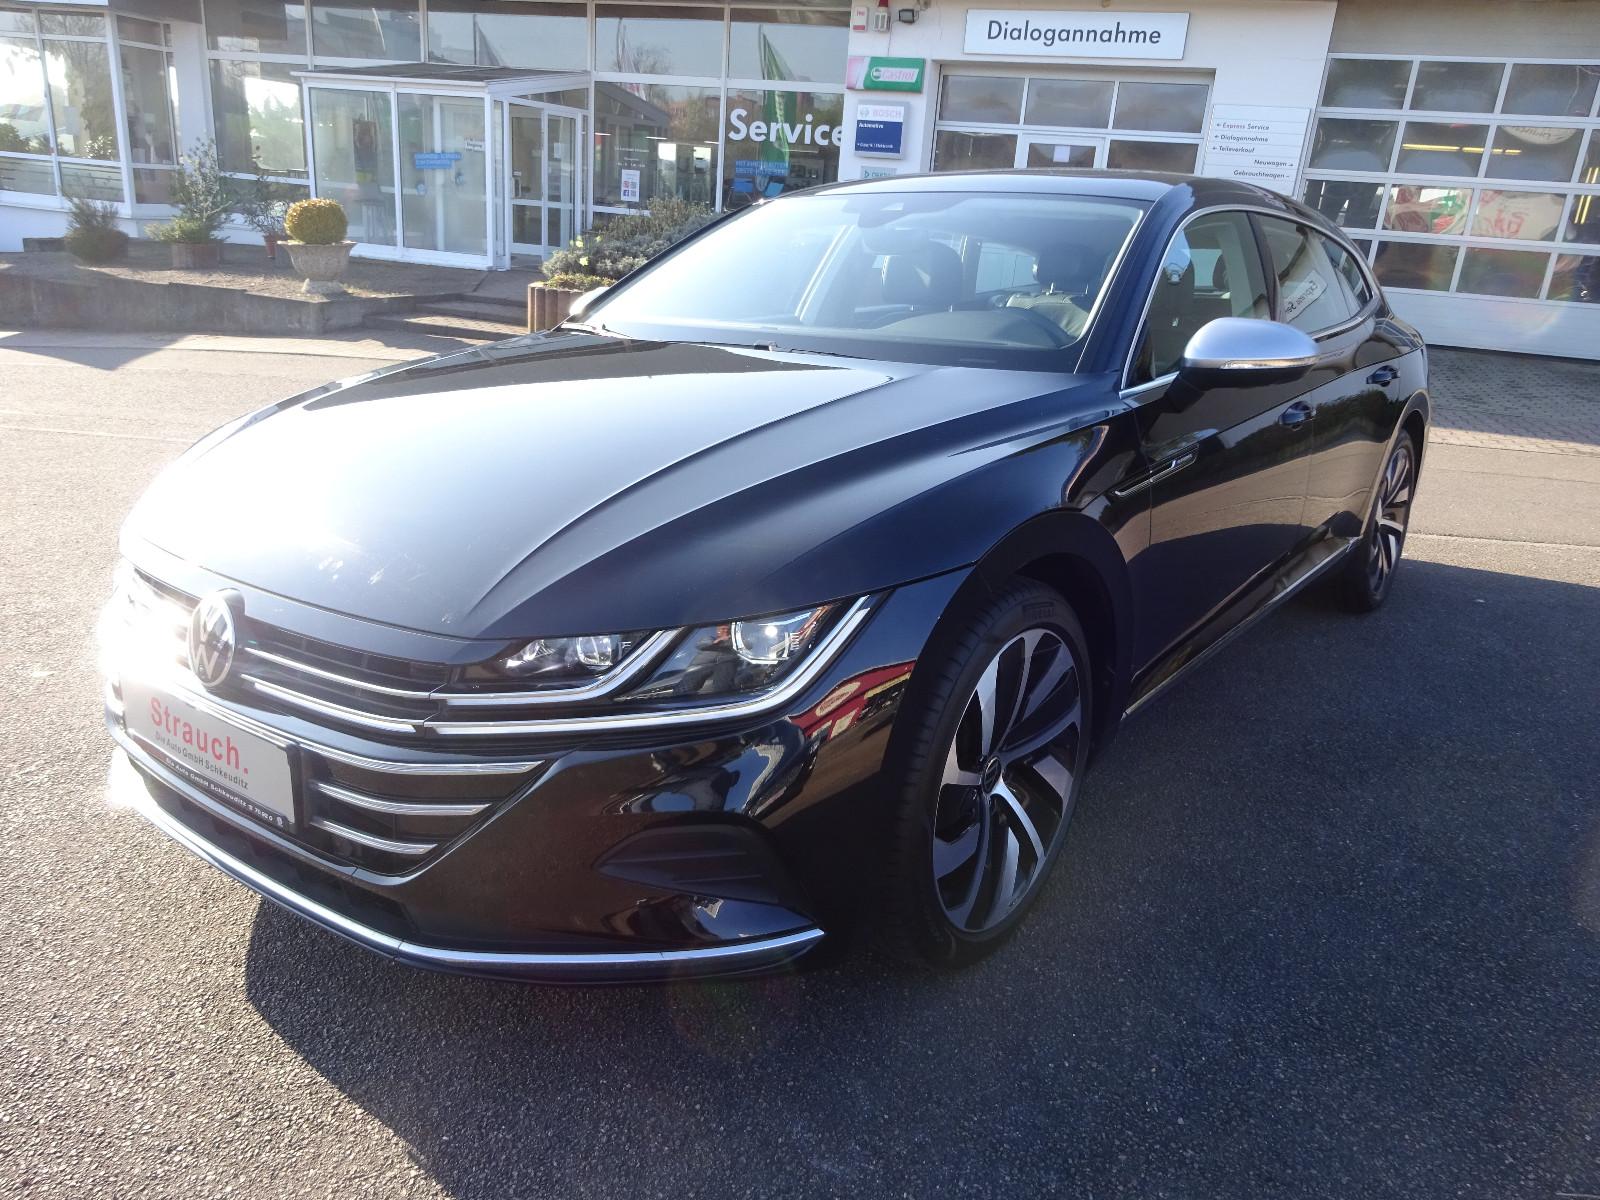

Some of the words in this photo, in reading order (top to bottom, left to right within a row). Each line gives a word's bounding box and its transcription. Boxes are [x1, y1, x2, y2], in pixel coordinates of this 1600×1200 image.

[987, 19, 1162, 47] Dialogannahme
[728, 108, 843, 147] Service
[1222, 122, 1246, 130] Express
[1247, 123, 1270, 131] Service
[1220, 134, 1269, 142] Dialogannahme
[1218, 145, 1255, 153] Teileverkauf
[1254, 159, 1287, 168] Neuwagen
[1233, 169, 1285, 180] Gebrauchtwagen
[150, 696, 249, 775] Strauch.
[166, 738, 182, 754] Auto
[182, 746, 204, 766] GmbH
[205, 759, 249, 790] Schkeuditz
[175, 764, 189, 776] Auto
[190, 773, 209, 787] GmbH
[210, 783, 247, 807] Schkeuditz
